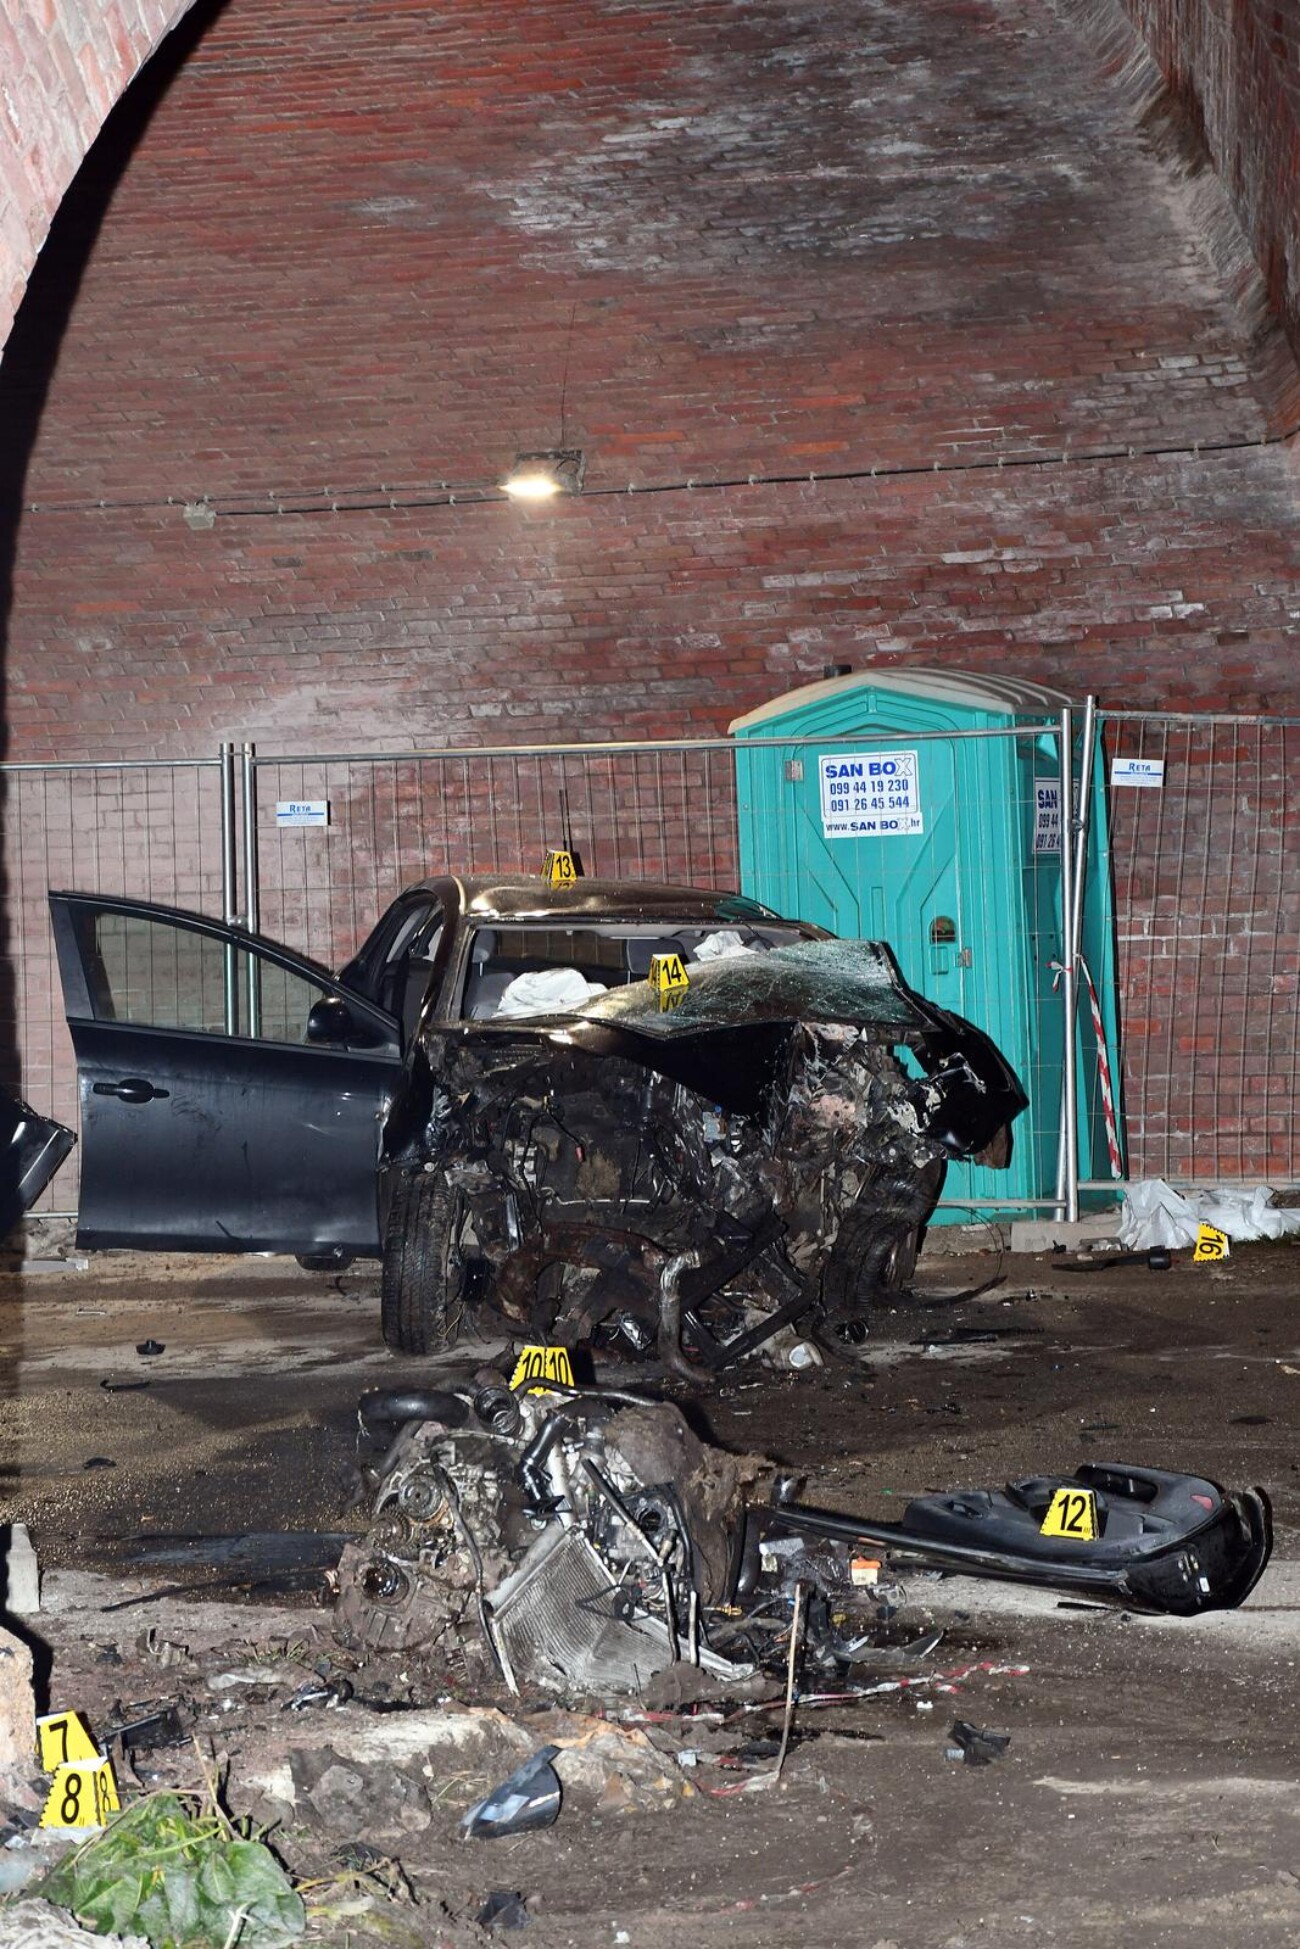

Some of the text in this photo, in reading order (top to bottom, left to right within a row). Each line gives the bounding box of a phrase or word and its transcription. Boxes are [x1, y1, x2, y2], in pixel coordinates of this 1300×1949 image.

[825, 758, 913, 779] SAN BOX
[830, 779, 909, 795] 099 44 19 230
[1037, 789, 1058, 809] SAN
[831, 795, 910, 812] 091 26 45 544
[556, 854, 571, 878] 13
[662, 957, 682, 985] 14
[1198, 1235, 1224, 1256] 16
[522, 1351, 542, 1380] 10
[550, 1351, 569, 1385] 10
[1058, 1494, 1087, 1533] 12
[48, 1719, 69, 1763] 7
[61, 1772, 83, 1825] 8
[99, 1770, 112, 1813] 8
